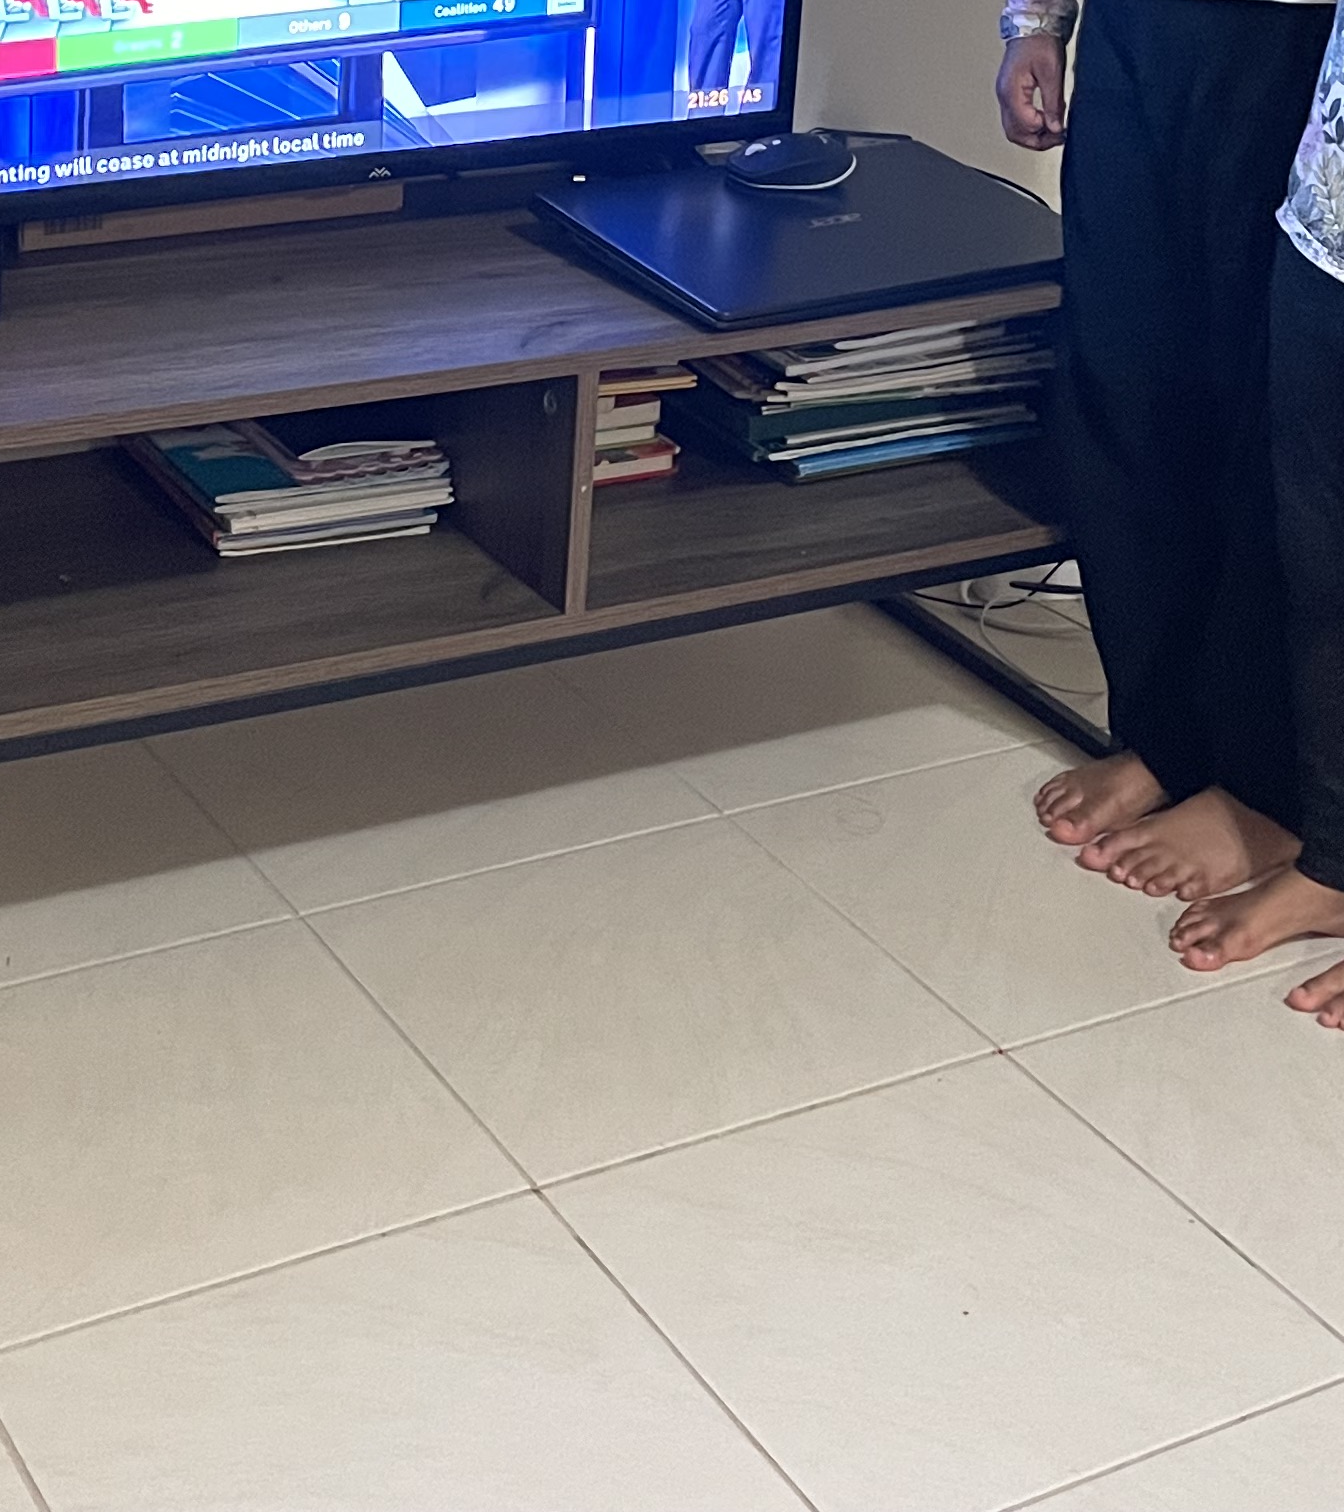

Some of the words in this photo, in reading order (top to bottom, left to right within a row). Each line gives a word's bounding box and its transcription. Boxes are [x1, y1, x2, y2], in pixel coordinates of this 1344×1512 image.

[434, 2, 487, 18] Coalition
[288, 17, 332, 34] Others
[338, 12, 351, 30] 9
[687, 89, 729, 109] 21:26
[737, 88, 762, 104] TAS
[55, 155, 93, 178] will
[158, 149, 179, 168] at
[182, 138, 271, 164] midnight
[272, 132, 319, 155] local
[322, 131, 366, 149] time
